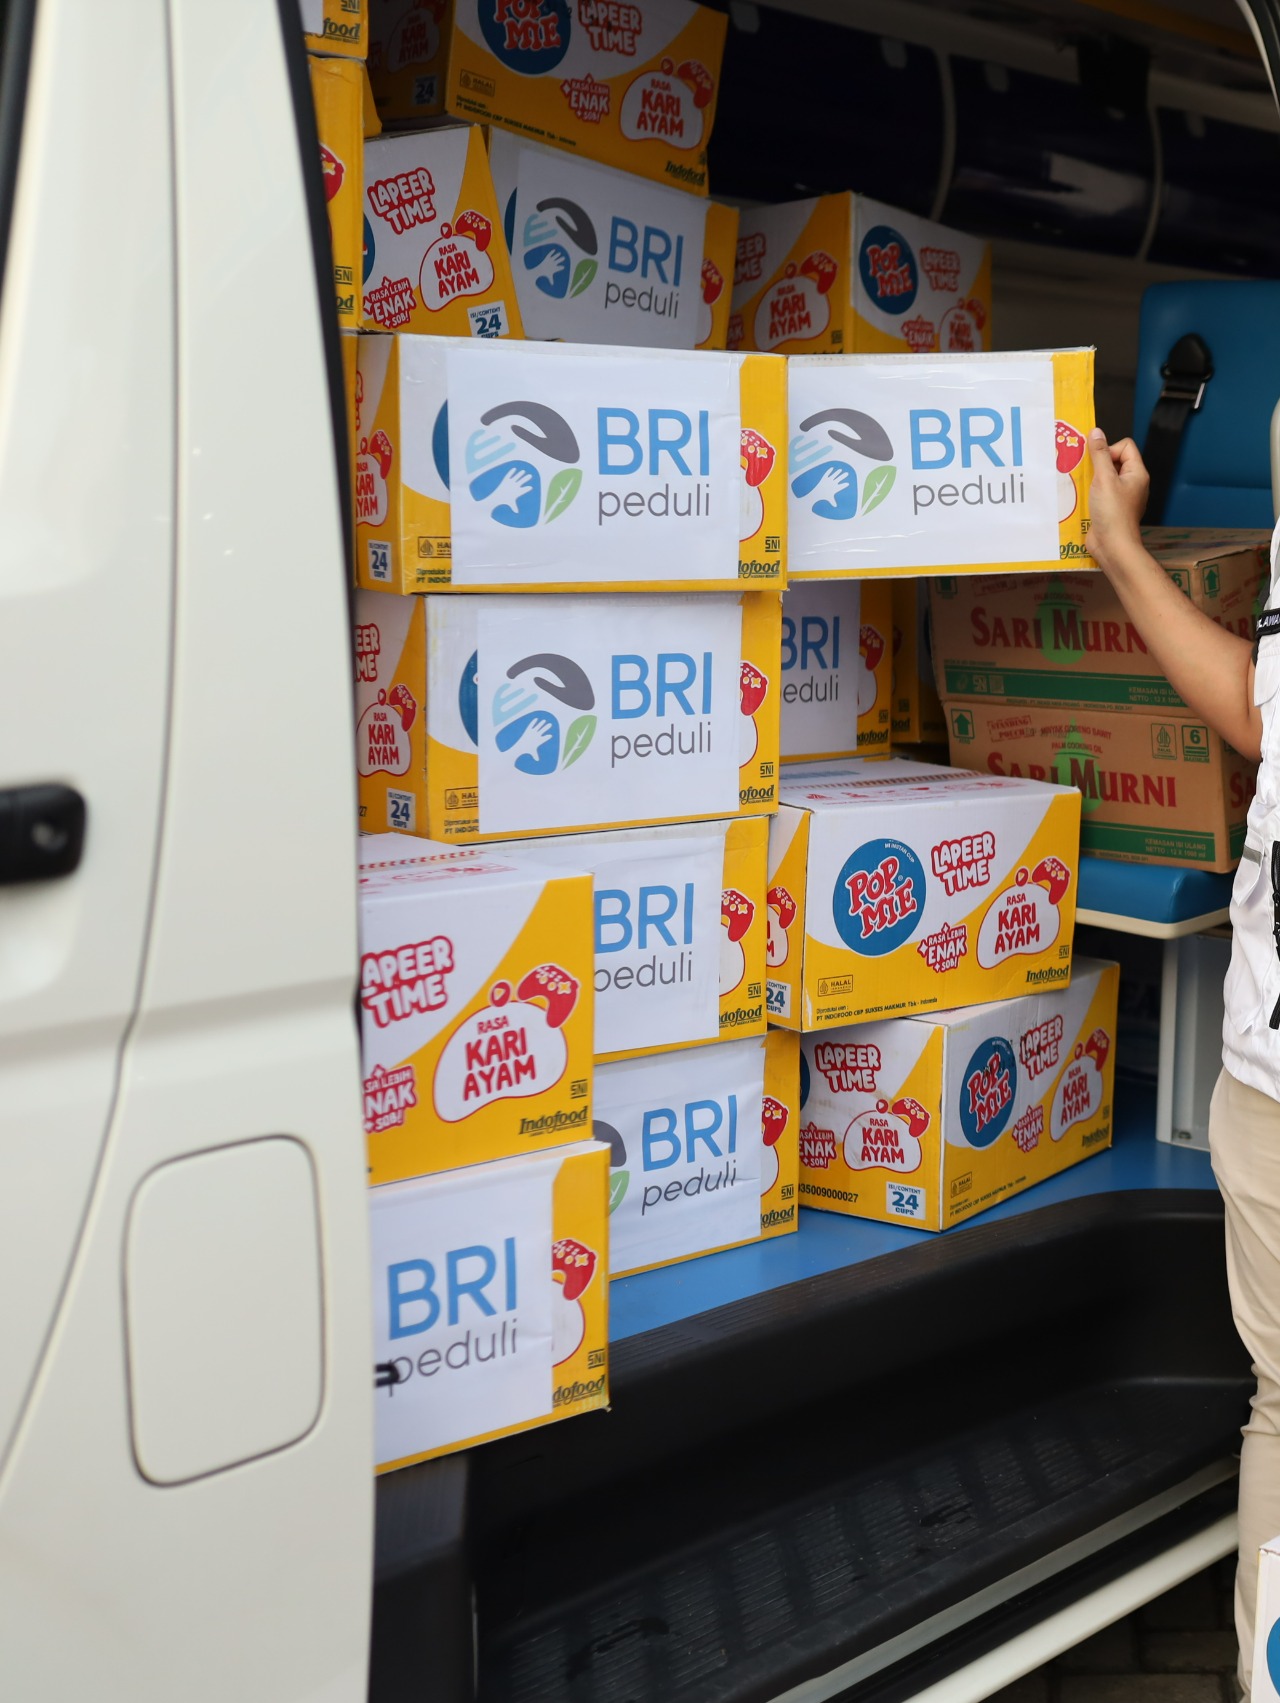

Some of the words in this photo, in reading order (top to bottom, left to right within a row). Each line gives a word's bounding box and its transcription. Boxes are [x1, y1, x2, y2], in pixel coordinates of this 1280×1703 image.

[504, 14, 561, 50] MIE
[590, 26, 637, 54] TIME
[570, 96, 609, 113] ENAK
[641, 89, 681, 115] KARI
[636, 111, 684, 138] AYAM
[369, 168, 434, 214] LAPEER
[386, 196, 436, 233] TIME
[434, 250, 471, 279] KARI
[438, 243, 458, 256] RASA
[607, 216, 684, 287] BRI
[867, 243, 901, 275] POP
[438, 268, 480, 298] AYAM
[877, 265, 914, 298] MIE
[374, 291, 415, 316] ENAK
[605, 281, 680, 319] peduli
[770, 293, 806, 319] KARI
[475, 313, 502, 336] 24
[769, 312, 811, 339] AYAM
[597, 407, 710, 476] BRI
[910, 406, 1022, 470] BRI
[598, 484, 710, 526] peduli
[913, 473, 1025, 516] peduli
[765, 539, 780, 549] SNI
[371, 550, 387, 571] 24
[781, 616, 840, 671] BRI
[970, 606, 1045, 650] SARI
[1053, 608, 1149, 655] MURN
[611, 652, 712, 719] BRI
[783, 674, 839, 704] eduli
[368, 724, 395, 745] KARI
[611, 721, 711, 768] peduli
[1189, 729, 1201, 745] 6
[368, 746, 400, 766] AYAM
[760, 764, 774, 775] SNI
[1069, 757, 1178, 808] MURNI
[391, 800, 411, 821] 24
[933, 832, 995, 874] LAPEER
[846, 857, 899, 914] POP
[943, 858, 990, 896] TIME
[860, 878, 917, 939] MIE
[1006, 893, 1026, 906] RASA
[594, 883, 695, 954] BRI
[998, 904, 1037, 932] KARI
[928, 934, 947, 947] RASA
[947, 926, 966, 941] LEBIH
[928, 936, 967, 965] ENAK
[995, 924, 1040, 955] AYAM
[1025, 965, 1069, 985] Indofood
[366, 973, 448, 1027] TIME
[477, 1015, 510, 1035] RASA
[824, 1011, 853, 1021] INDOFOOD
[465, 1027, 528, 1071] KARI
[816, 1043, 880, 1073] LAPEER
[1026, 1042, 1060, 1081] TIME
[463, 1054, 537, 1102] AYAM
[824, 1068, 878, 1093] TIME
[1063, 1075, 1088, 1104] KARI
[975, 1070, 1012, 1132] MIE
[1061, 1093, 1090, 1127] AYAM
[519, 1106, 588, 1135] Indofood
[642, 1094, 738, 1172] BRI
[869, 1117, 889, 1128] RASA
[1018, 1118, 1044, 1148] ENAK
[862, 1127, 900, 1146] KARI
[861, 1147, 905, 1165] AYAM
[641, 1159, 737, 1216] peduli
[799, 1183, 859, 1203] 35009000027
[892, 1191, 920, 1210] 24
[895, 1206, 915, 1217] CUPS
[387, 1237, 517, 1341] BRI
[388, 1319, 518, 1397] peduli
